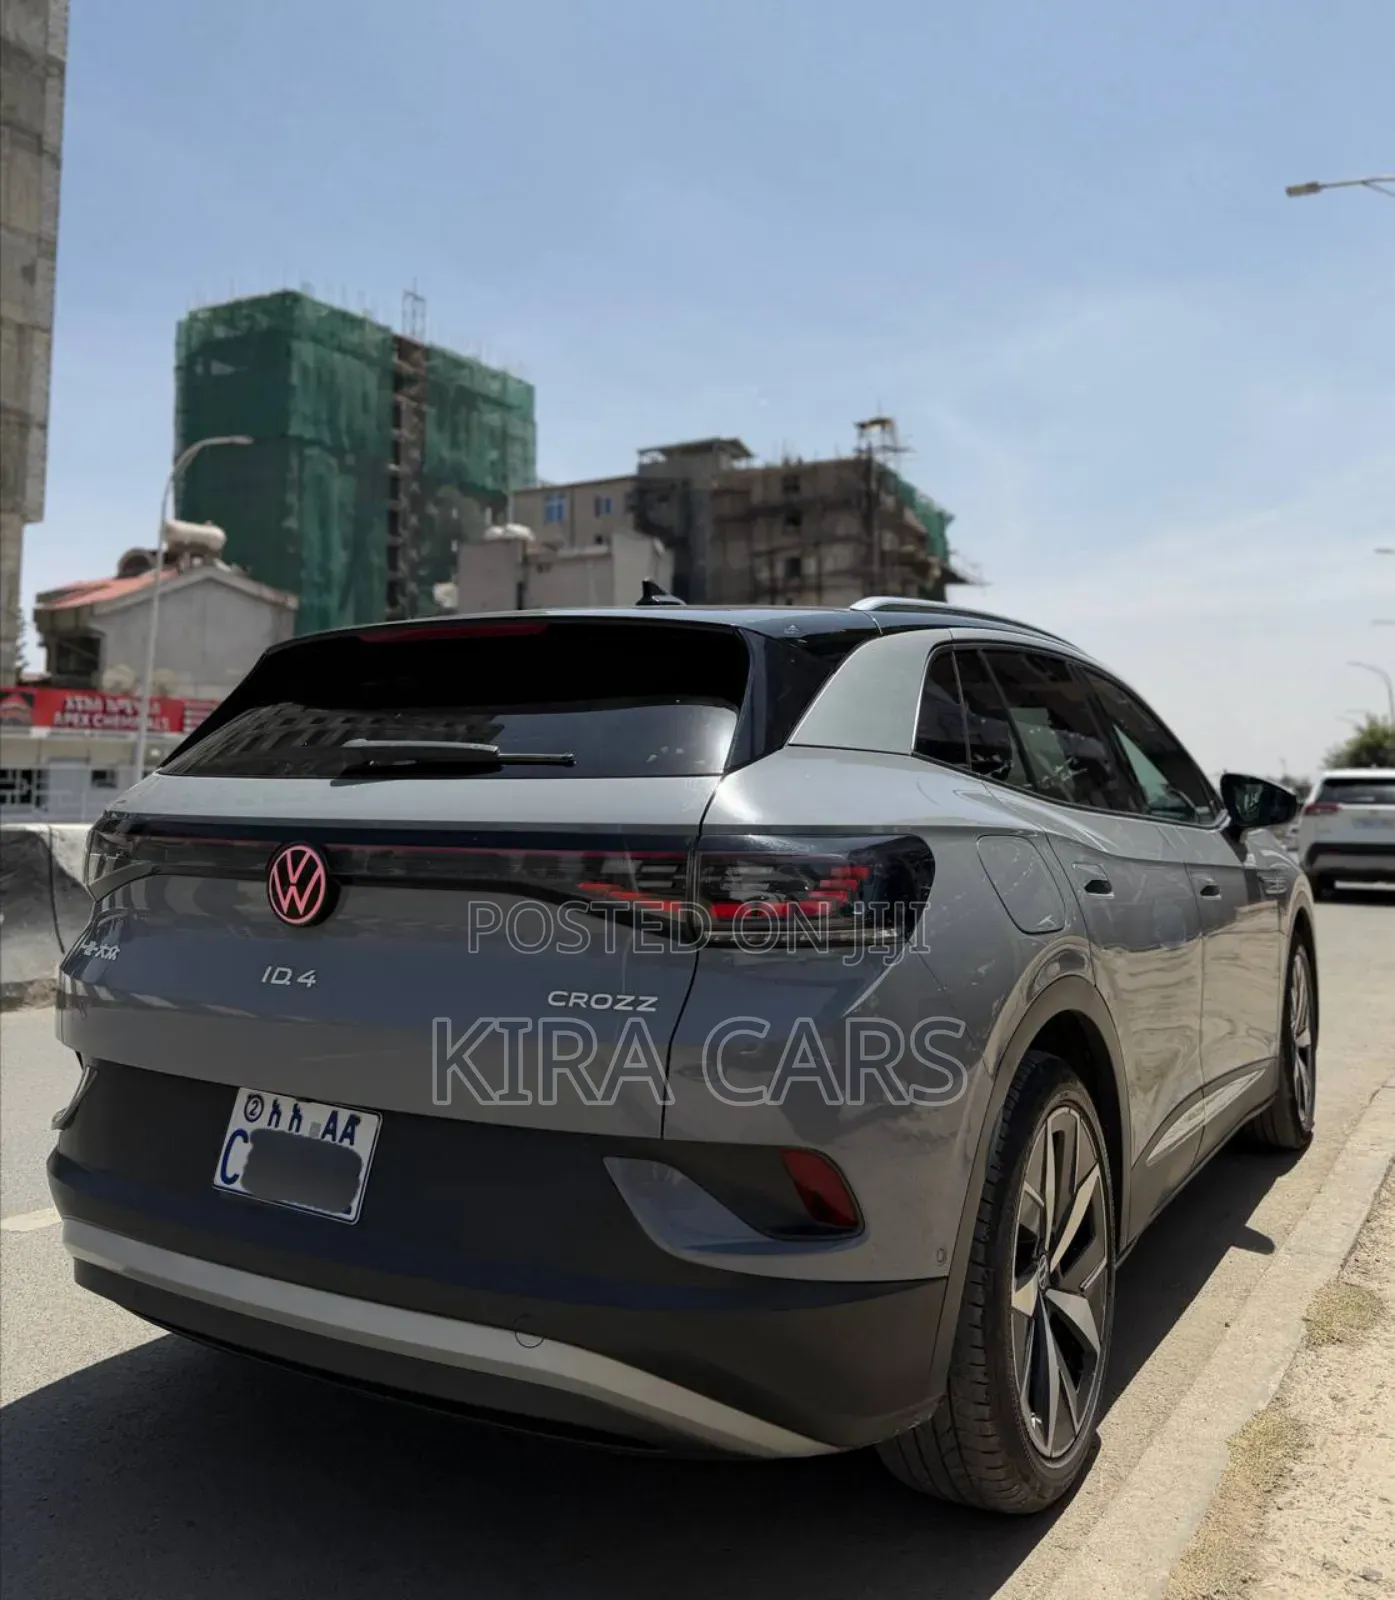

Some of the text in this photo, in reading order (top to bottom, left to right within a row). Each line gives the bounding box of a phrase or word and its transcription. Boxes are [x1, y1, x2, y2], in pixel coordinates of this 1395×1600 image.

[547, 990, 659, 1012] CROZZ
[320, 1109, 361, 1146] AA
[220, 1128, 249, 1185] C
